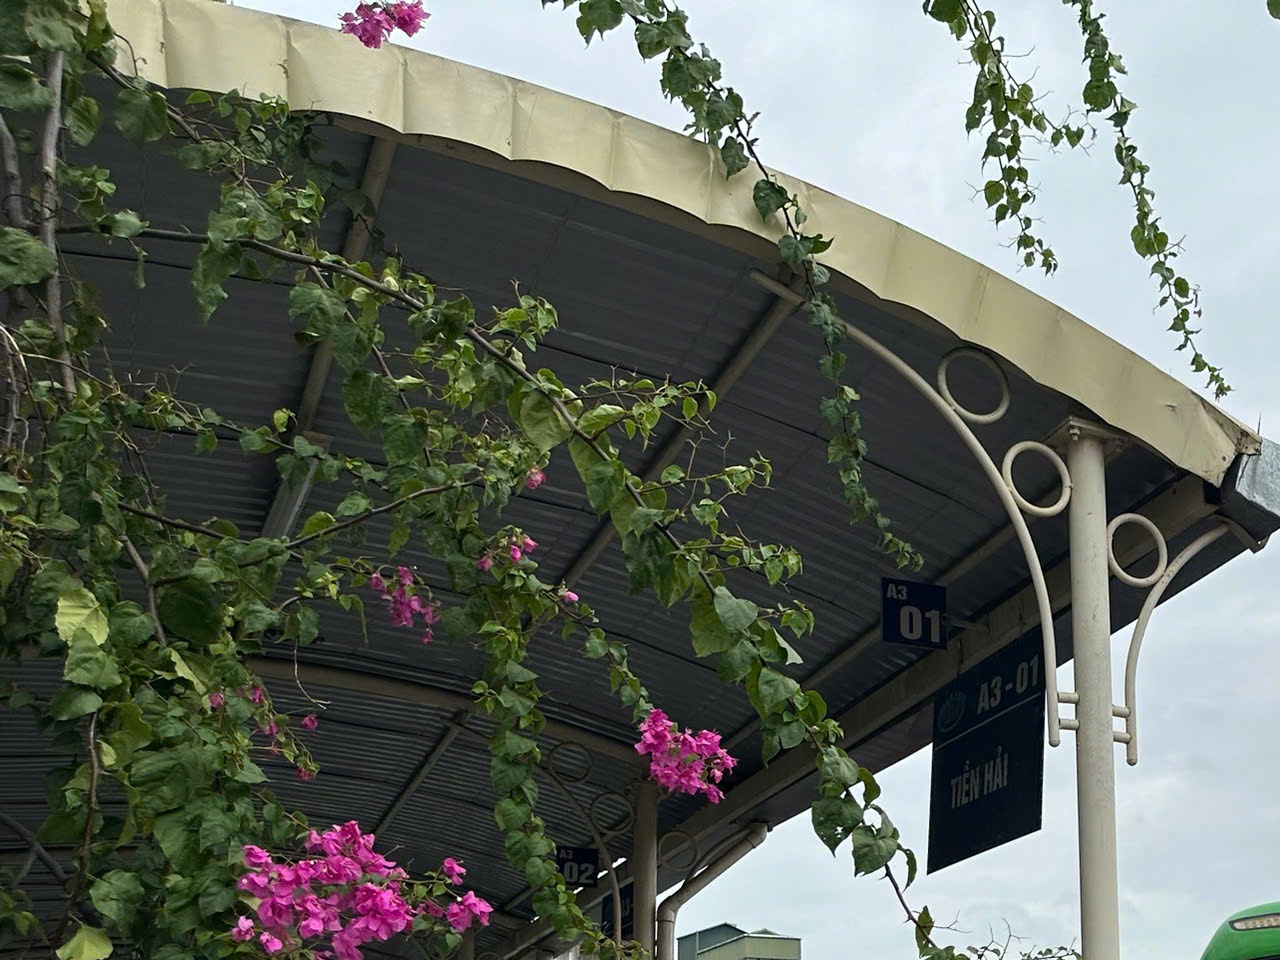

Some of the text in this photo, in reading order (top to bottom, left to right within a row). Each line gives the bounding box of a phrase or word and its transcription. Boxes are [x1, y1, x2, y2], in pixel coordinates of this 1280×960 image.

[887, 583, 907, 600] A3
[900, 605, 940, 643] 01
[983, 745, 1008, 794] HẢI
[559, 849, 573, 860] A3
[564, 863, 595, 884] 02
